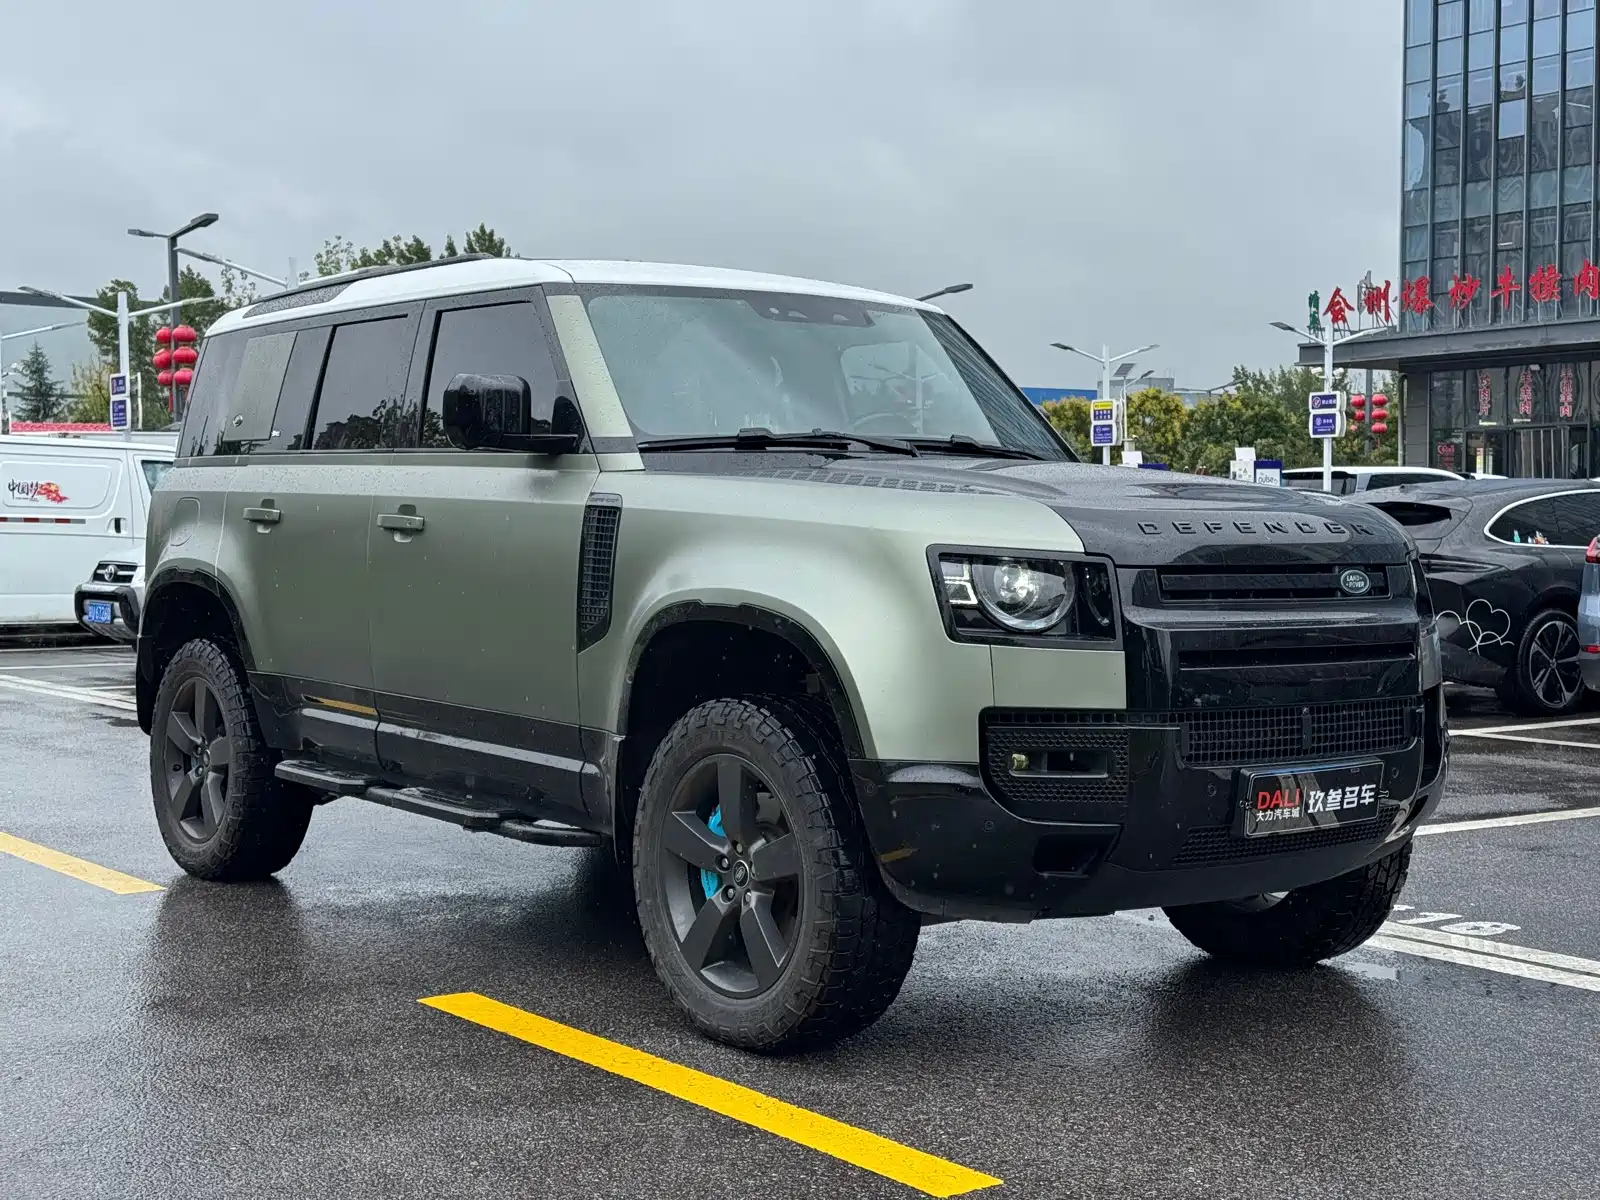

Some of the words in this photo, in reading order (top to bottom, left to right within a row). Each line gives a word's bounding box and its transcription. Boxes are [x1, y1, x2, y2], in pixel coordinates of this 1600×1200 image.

[1137, 520, 1375, 536] DEFENDER
[1256, 787, 1301, 810] DALI
[1307, 784, 1377, 814] 玖叁名车
[1256, 807, 1300, 822] 大力汽车城
